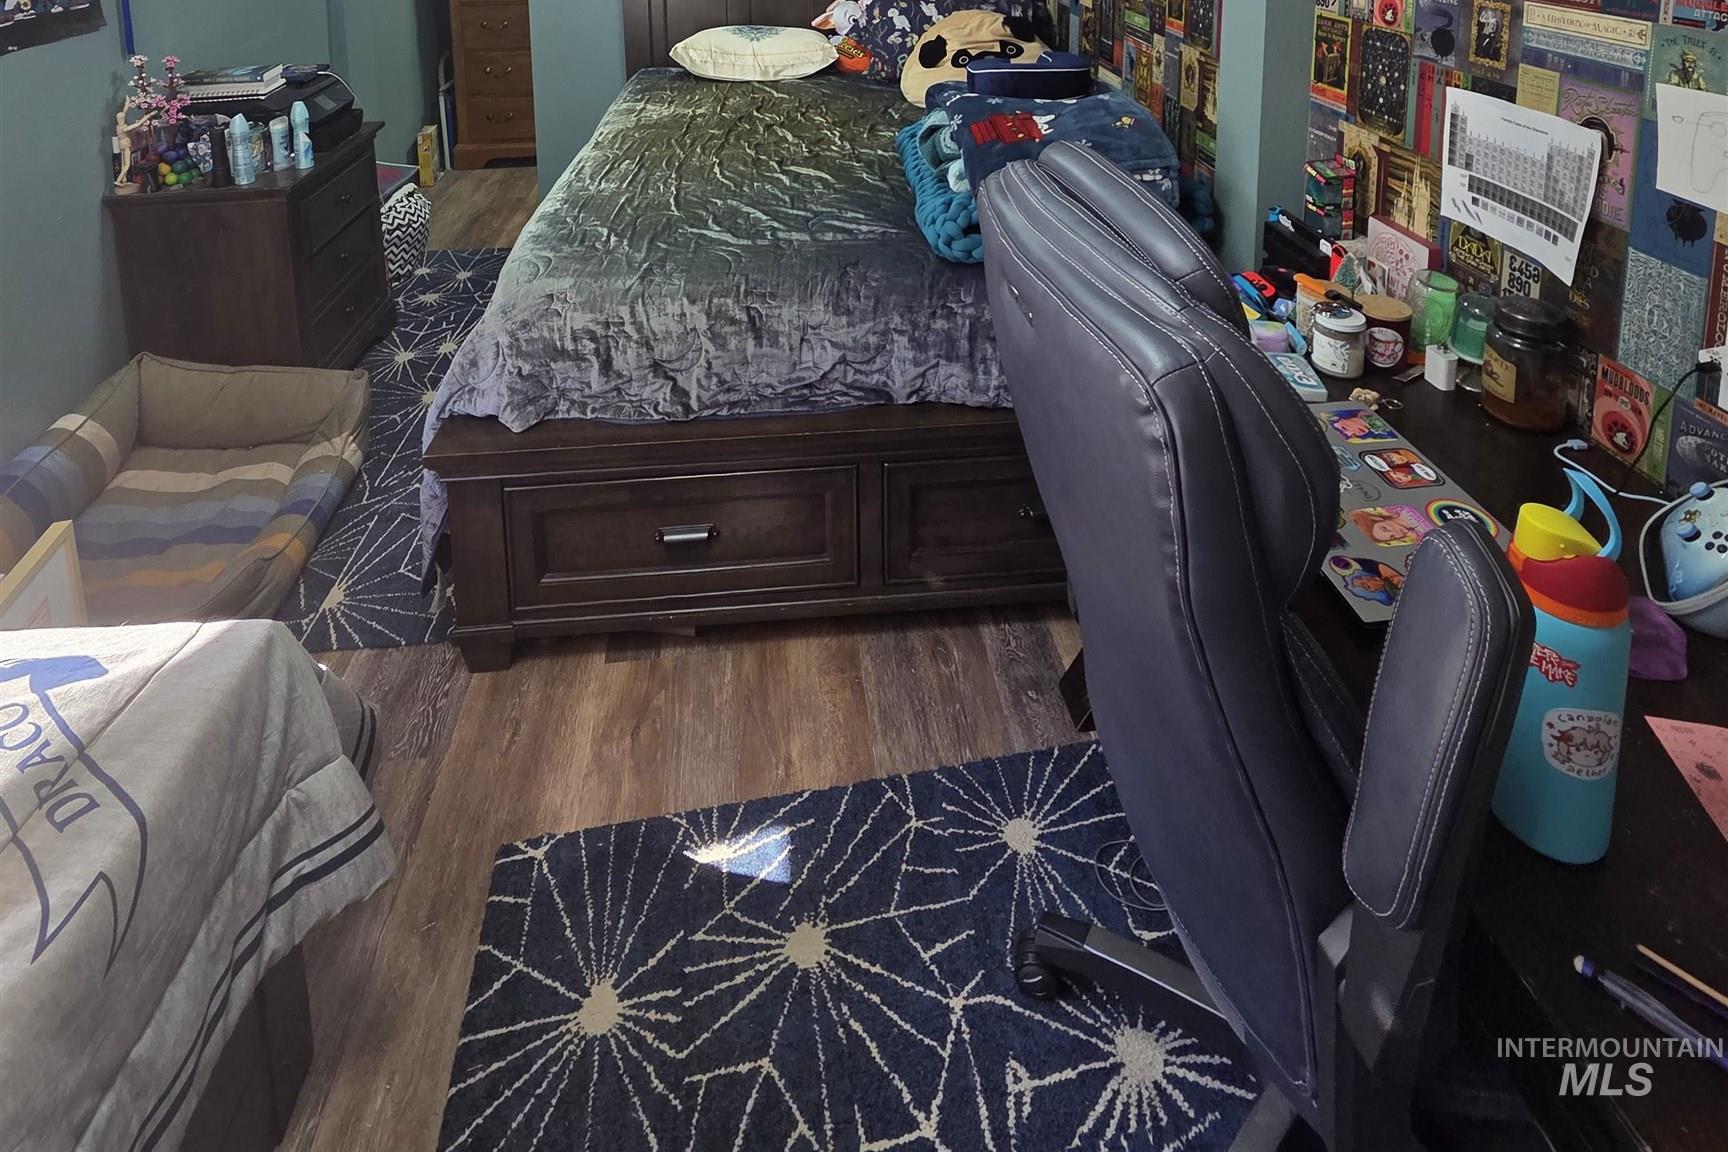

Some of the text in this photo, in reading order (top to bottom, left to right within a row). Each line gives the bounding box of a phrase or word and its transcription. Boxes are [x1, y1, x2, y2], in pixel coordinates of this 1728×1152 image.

[1693, 8, 1728, 22] ATTAC
[1601, 365, 1650, 406] MUDBLOODS
[1680, 419, 1728, 440] ADVANC
